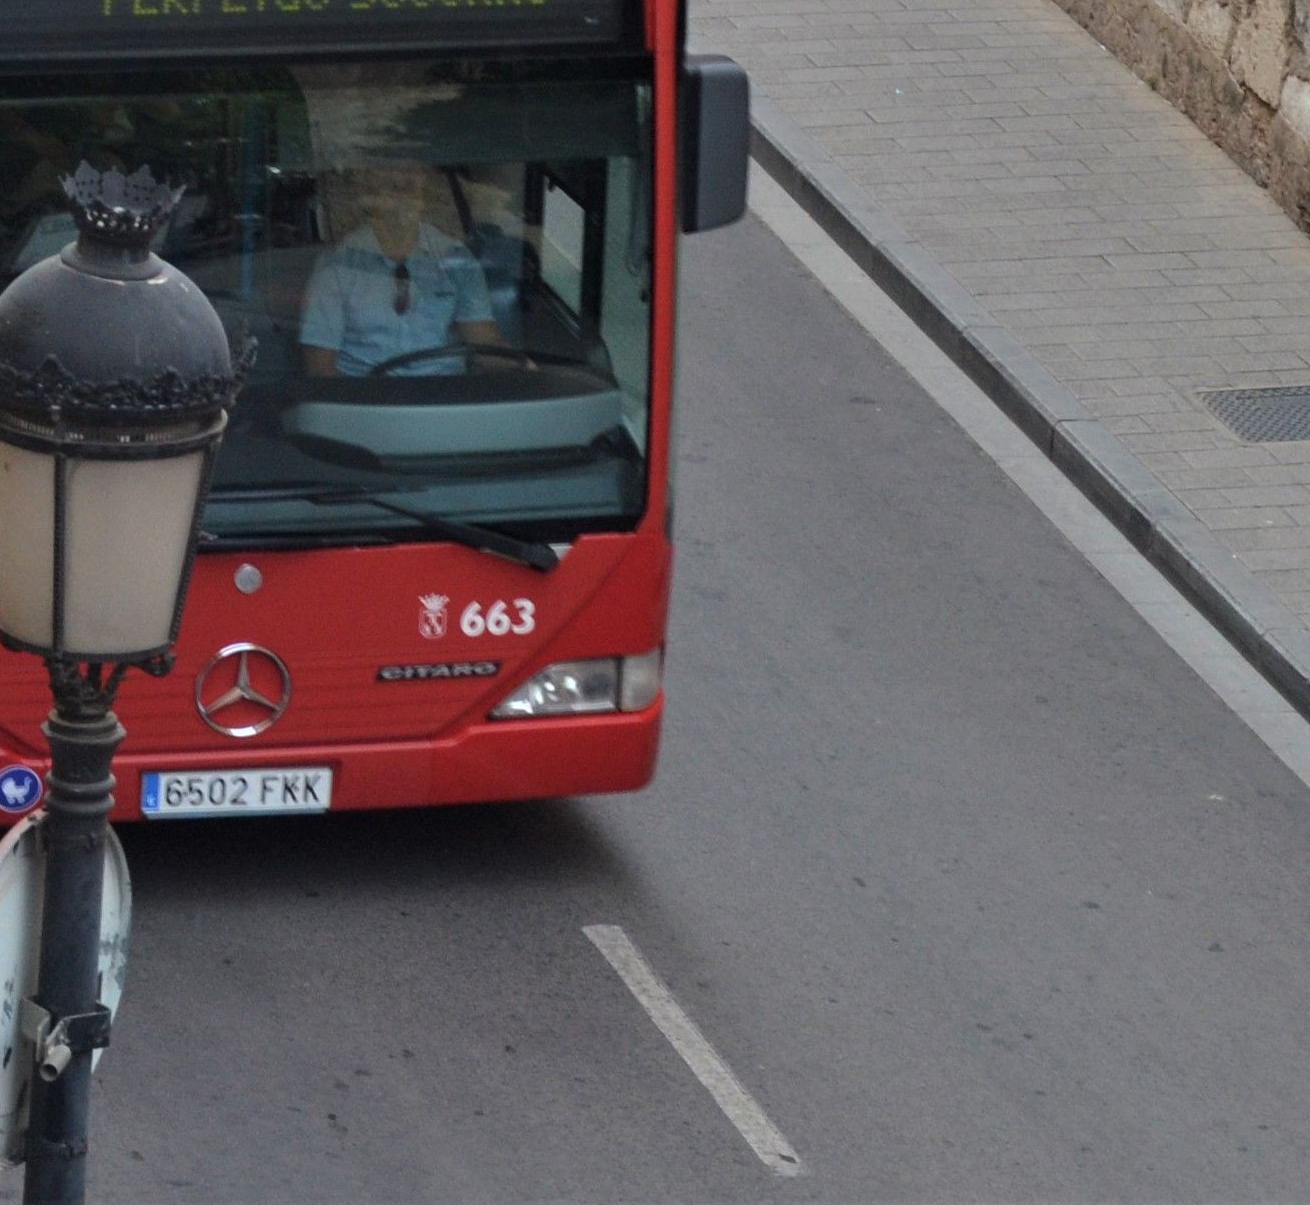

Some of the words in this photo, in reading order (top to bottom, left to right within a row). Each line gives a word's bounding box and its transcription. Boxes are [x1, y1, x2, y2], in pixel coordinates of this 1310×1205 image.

[459, 598, 536, 637] 663
[380, 661, 498, 680] CITARO
[164, 776, 249, 807] 6502
[259, 774, 321, 804] FKK
